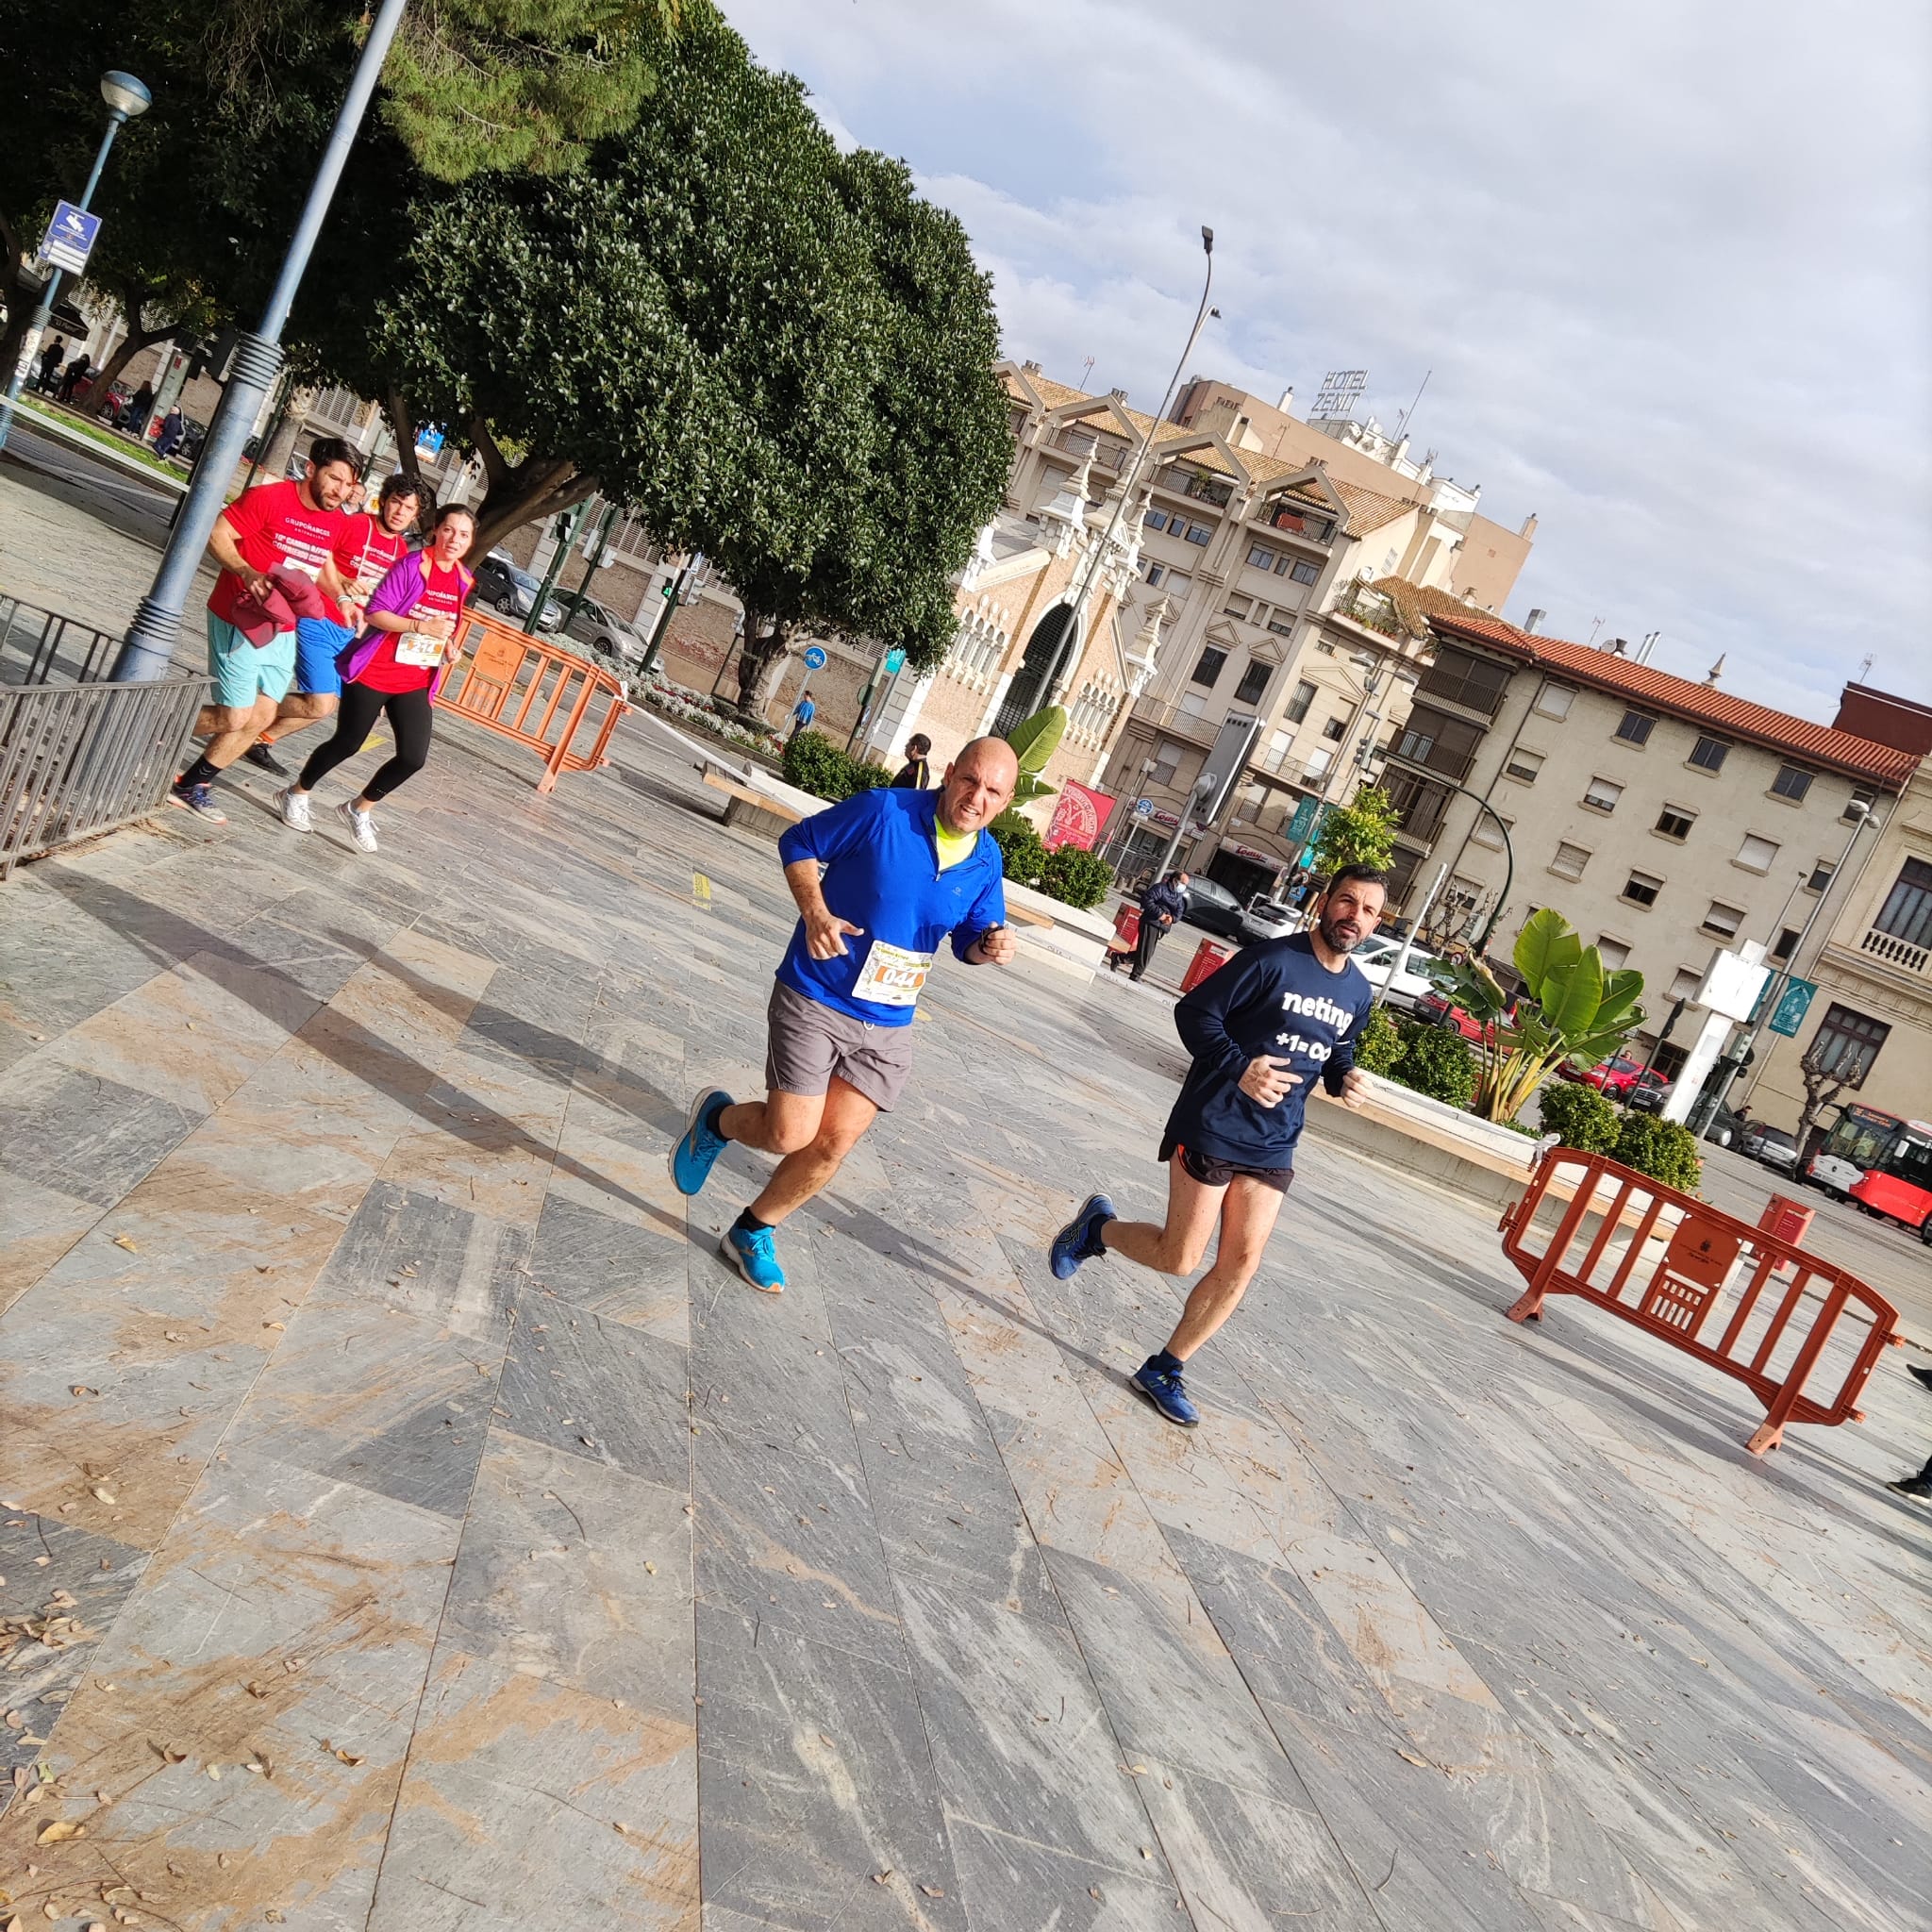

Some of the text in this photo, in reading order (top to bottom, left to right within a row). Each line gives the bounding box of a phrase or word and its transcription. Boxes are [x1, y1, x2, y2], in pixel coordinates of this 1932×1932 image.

[1322, 370, 1369, 390] HOTEL
[1311, 392, 1360, 411] ZENIT
[1282, 991, 1354, 1036] neting
